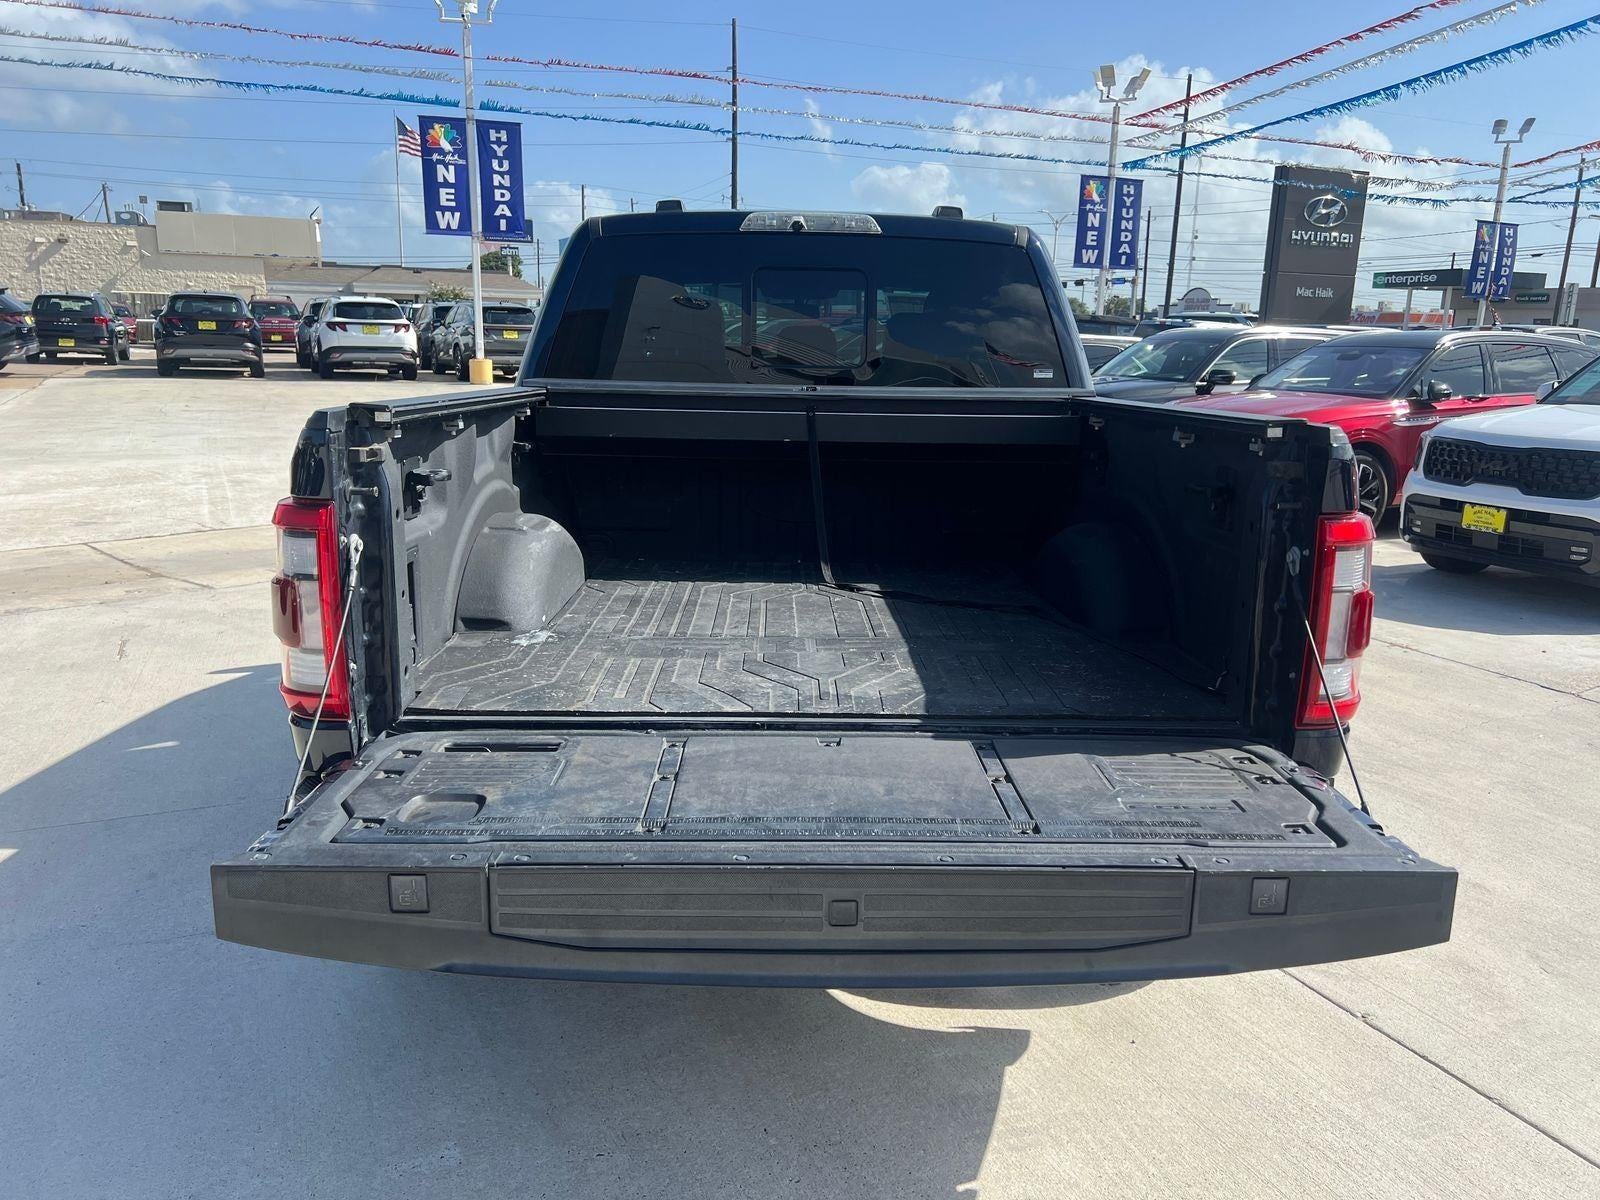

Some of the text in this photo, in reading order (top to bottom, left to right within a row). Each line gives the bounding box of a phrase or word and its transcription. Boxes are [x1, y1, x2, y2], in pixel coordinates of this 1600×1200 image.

[435, 164, 460, 230] NEW
[489, 129, 512, 231] HYUNDAI
[1081, 212, 1100, 264] NEW
[1118, 184, 1134, 265] HYUNDAI
[1291, 230, 1353, 248] HYUNDAI
[501, 247, 518, 255] atm
[1471, 251, 1489, 294] NEW
[1498, 227, 1513, 295] HYUNDAI
[1296, 287, 1334, 298] Mac Haik
[1375, 273, 1437, 285] enterprise
